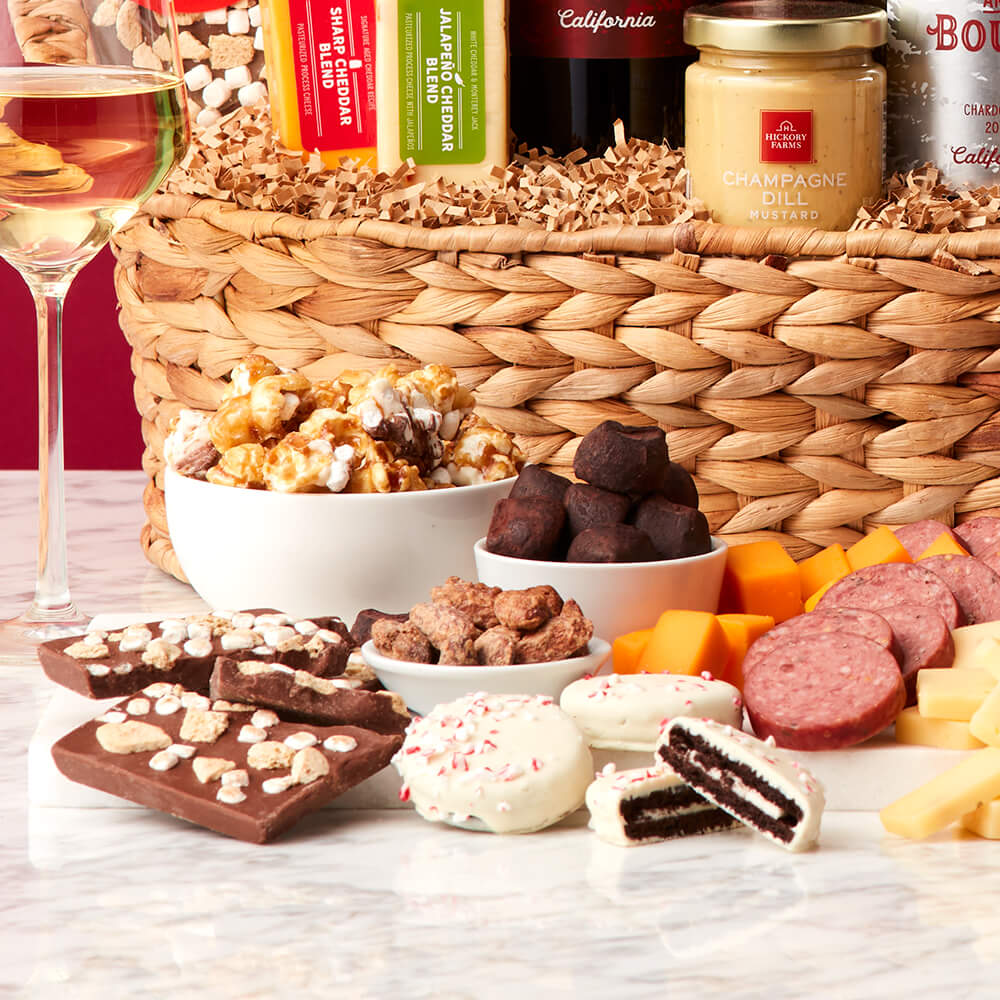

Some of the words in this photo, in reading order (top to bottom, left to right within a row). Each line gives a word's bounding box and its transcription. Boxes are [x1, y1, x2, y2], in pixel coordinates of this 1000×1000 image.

[330, 6, 346, 55] SHARP
[404, 13, 413, 50] PASTEURIZED
[557, 8, 656, 33] California
[296, 23, 307, 63] PASTEURIZED
[440, 8, 455, 82] JALAPEÑO
[319, 42, 334, 89] BLEND
[405, 52, 413, 77] PROCESS
[300, 64, 310, 92] PROCESS
[406, 78, 414, 99] CHEESE
[426, 58, 439, 104] BLEND
[302, 92, 313, 116] CHEESE
[334, 58, 352, 126] CHEDDAR
[440, 86, 454, 152] CHEDDAR
[765, 133, 808, 141] HICKORY
[770, 141, 802, 149] FARMS
[722, 171, 847, 188] CHAMPAGNE
[762, 192, 809, 206] DILL
[750, 210, 818, 220] MUSTARD
